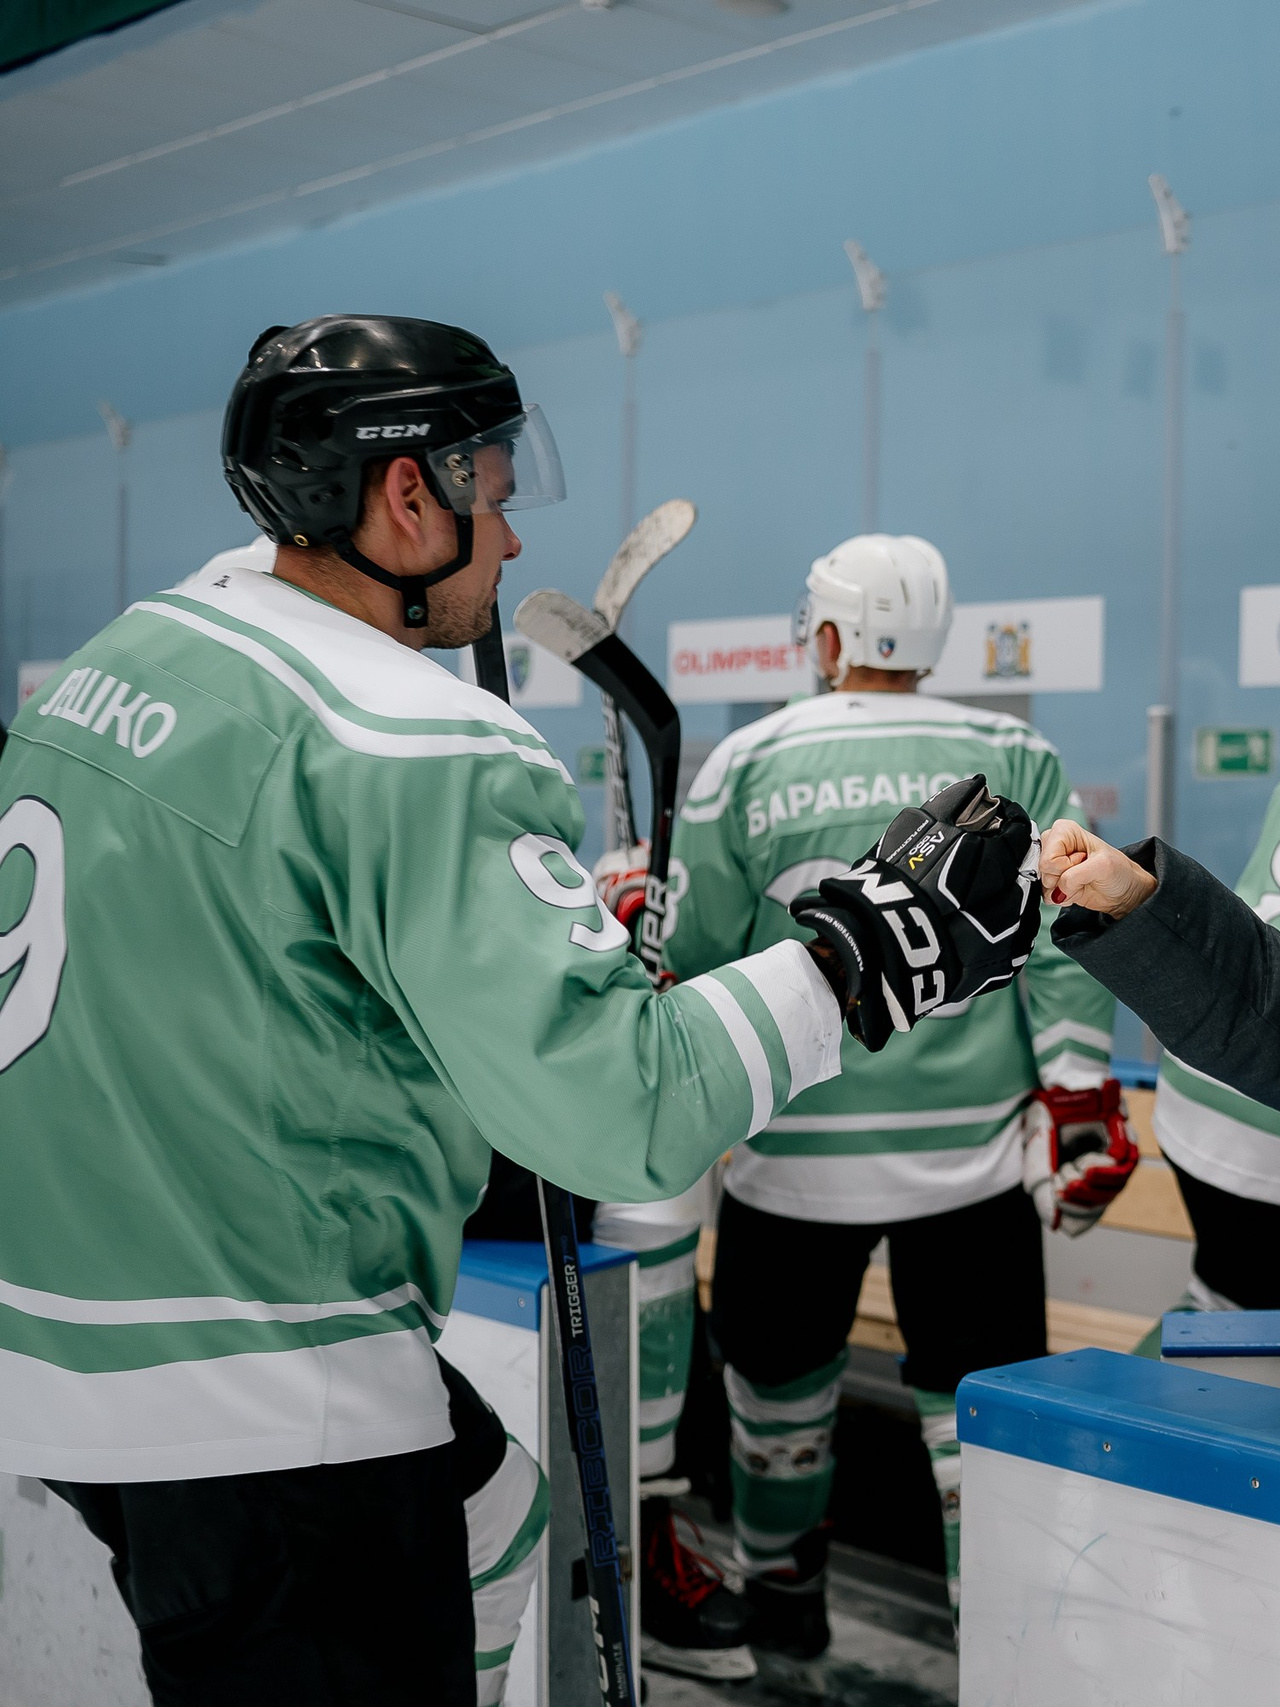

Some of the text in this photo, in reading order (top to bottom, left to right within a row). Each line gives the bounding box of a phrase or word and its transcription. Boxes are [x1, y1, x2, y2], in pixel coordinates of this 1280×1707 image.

[356, 423, 432, 440] CCM
[674, 644, 805, 675] OLIMPBET
[746, 772, 976, 838] БАРАБАНО
[508, 831, 632, 952] 9
[832, 857, 946, 1017] CCM
[564, 1263, 583, 1338] TRIGGER
